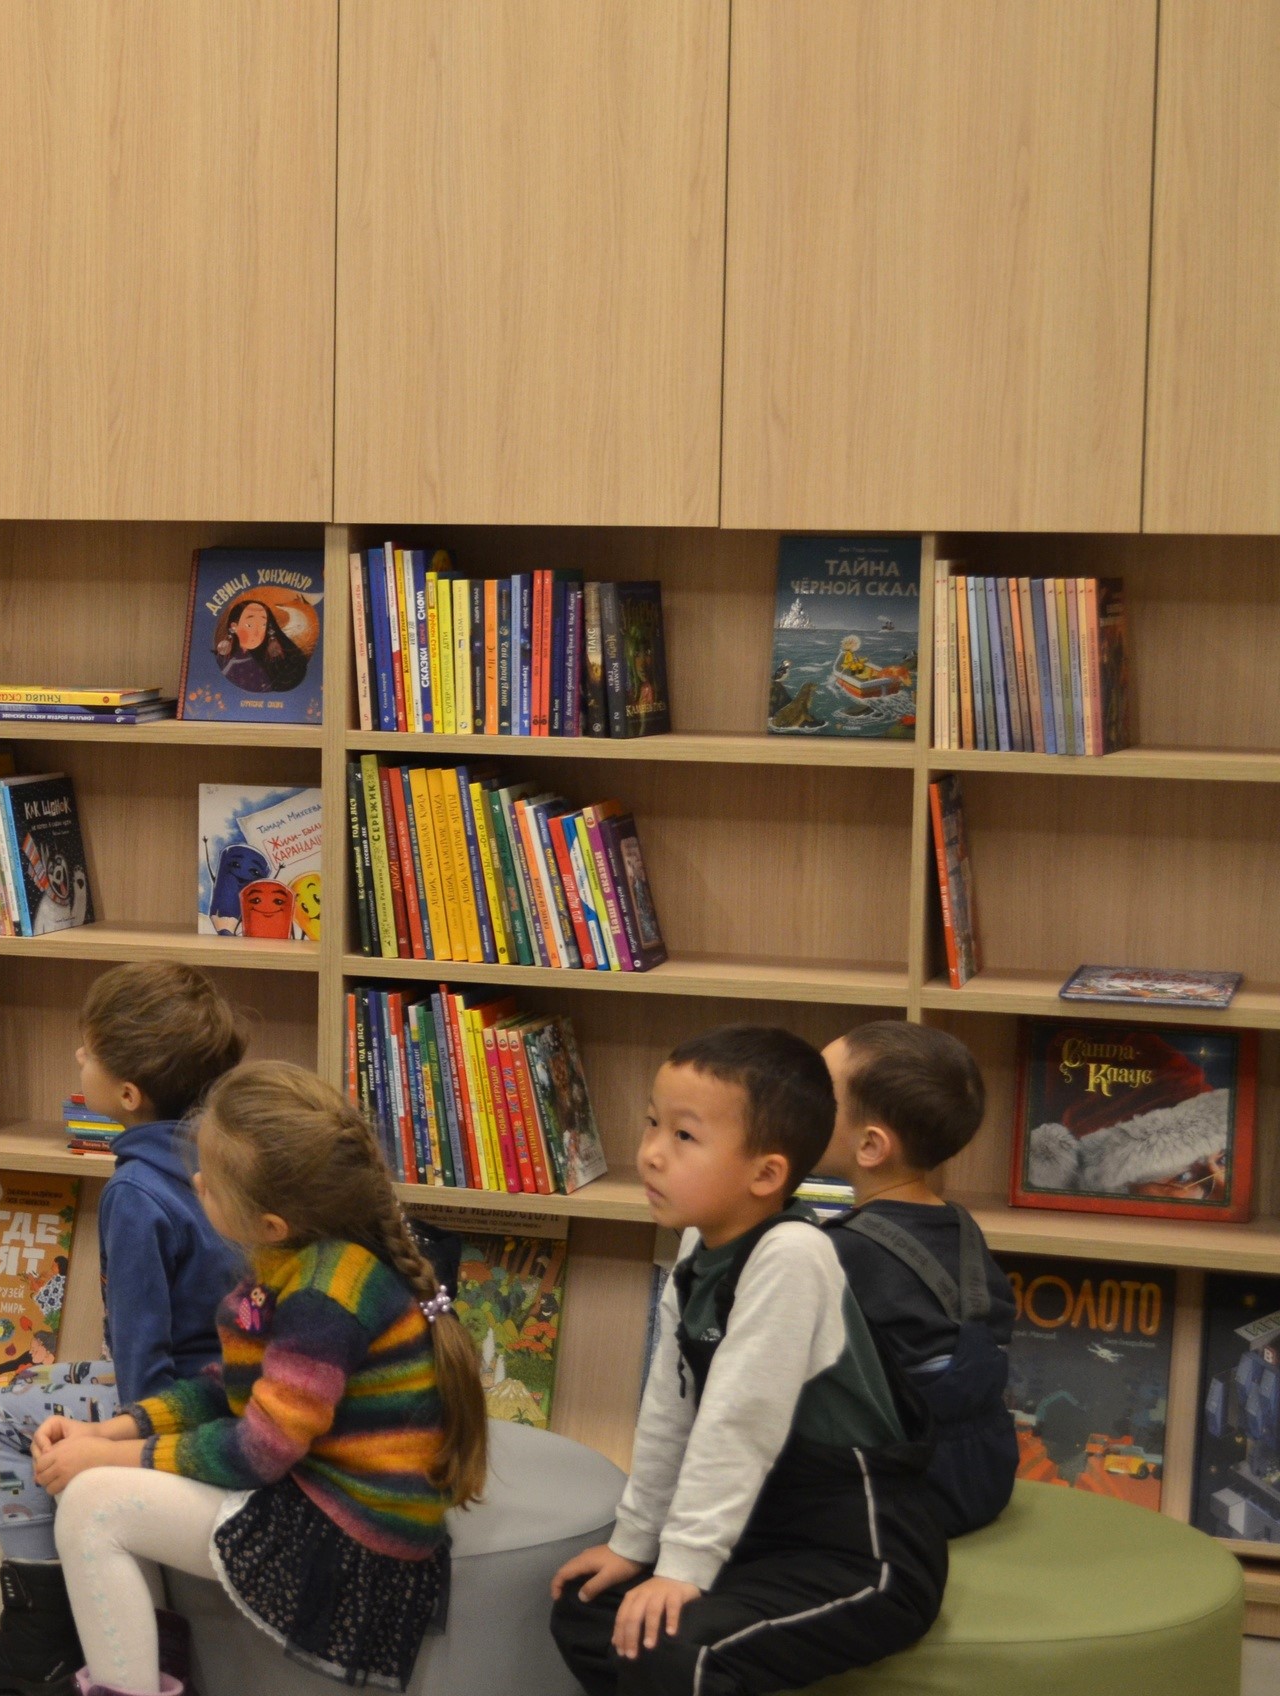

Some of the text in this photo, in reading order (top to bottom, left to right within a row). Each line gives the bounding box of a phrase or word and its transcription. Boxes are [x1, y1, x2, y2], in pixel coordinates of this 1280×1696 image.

[824, 557, 901, 577] ТАЙНА
[205, 568, 313, 616] ДЕВИЦА ХОНХИНУР
[790, 578, 918, 597] ЧЁРНОЙ СКАЛ
[416, 590, 425, 619] СНОМ
[587, 627, 595, 652] ПАКС
[419, 647, 429, 687] СКАЗКИ
[24, 693, 61, 703] Книга
[24, 800, 41, 820] КАК
[349, 798, 357, 812] ЛЕСУ
[256, 804, 322, 834] Тамара Михеева
[271, 836, 322, 863] КАРАНДАШ
[362, 839, 370, 866] РУССКИЙ
[593, 850, 620, 935] Наши сказки
[356, 1023, 364, 1039] ЛЕСУ
[516, 1068, 529, 1108] РАССКАЗЫ
[1084, 1062, 1153, 1097] Клаус
[490, 1065, 507, 1136] НОВАЯ ИГРУШКА
[0, 1302, 26, 1314] МИРА
